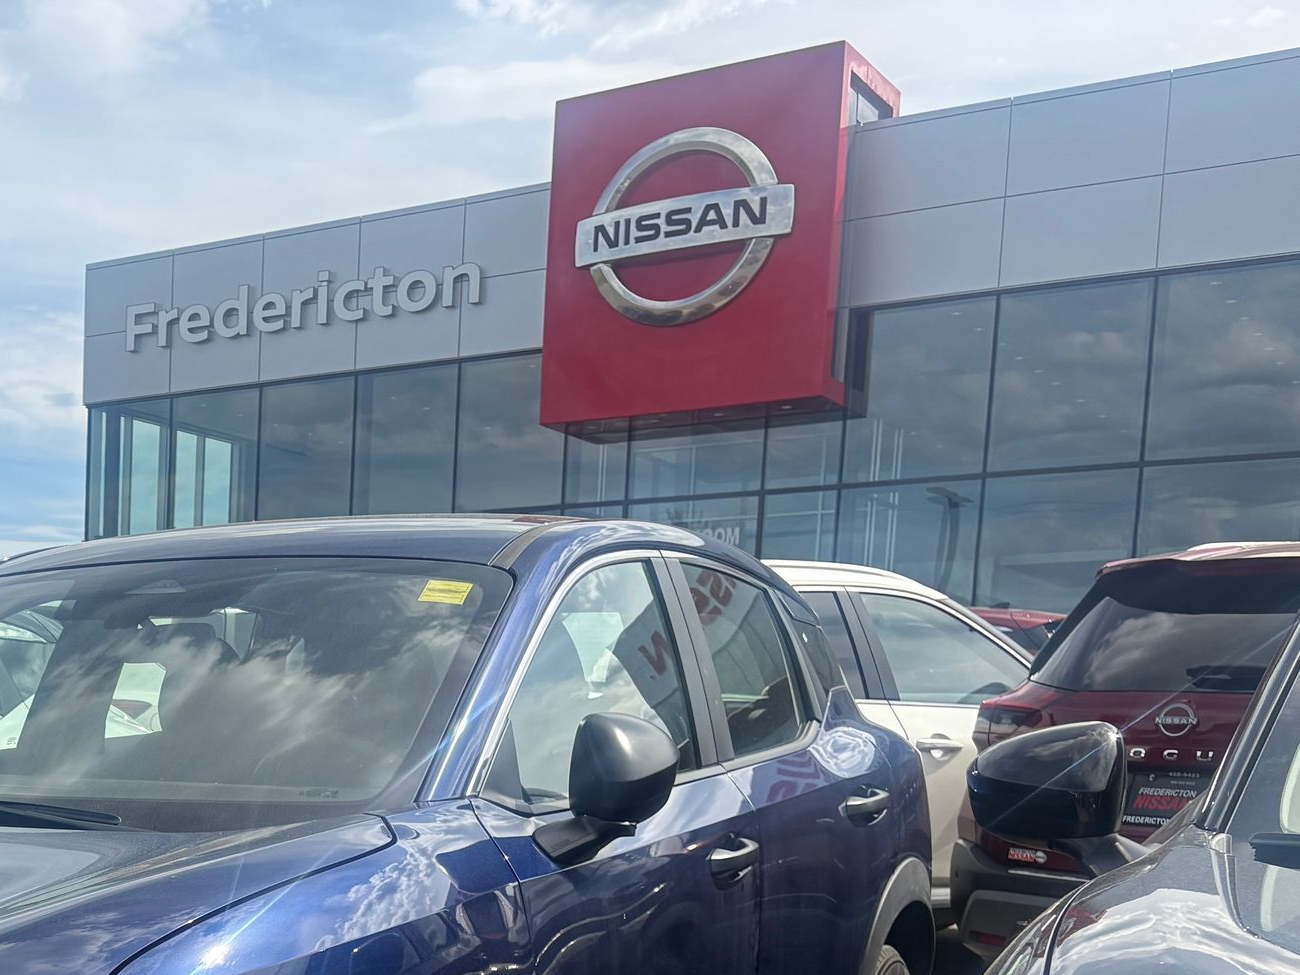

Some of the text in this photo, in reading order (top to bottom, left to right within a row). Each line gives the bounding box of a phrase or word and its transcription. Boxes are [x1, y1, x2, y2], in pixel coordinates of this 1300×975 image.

[591, 195, 769, 254] NISSAN
[124, 261, 482, 354] Fredericton
[1154, 716, 1198, 726] NISSAN
[1138, 787, 1198, 798] FREDERICTON
